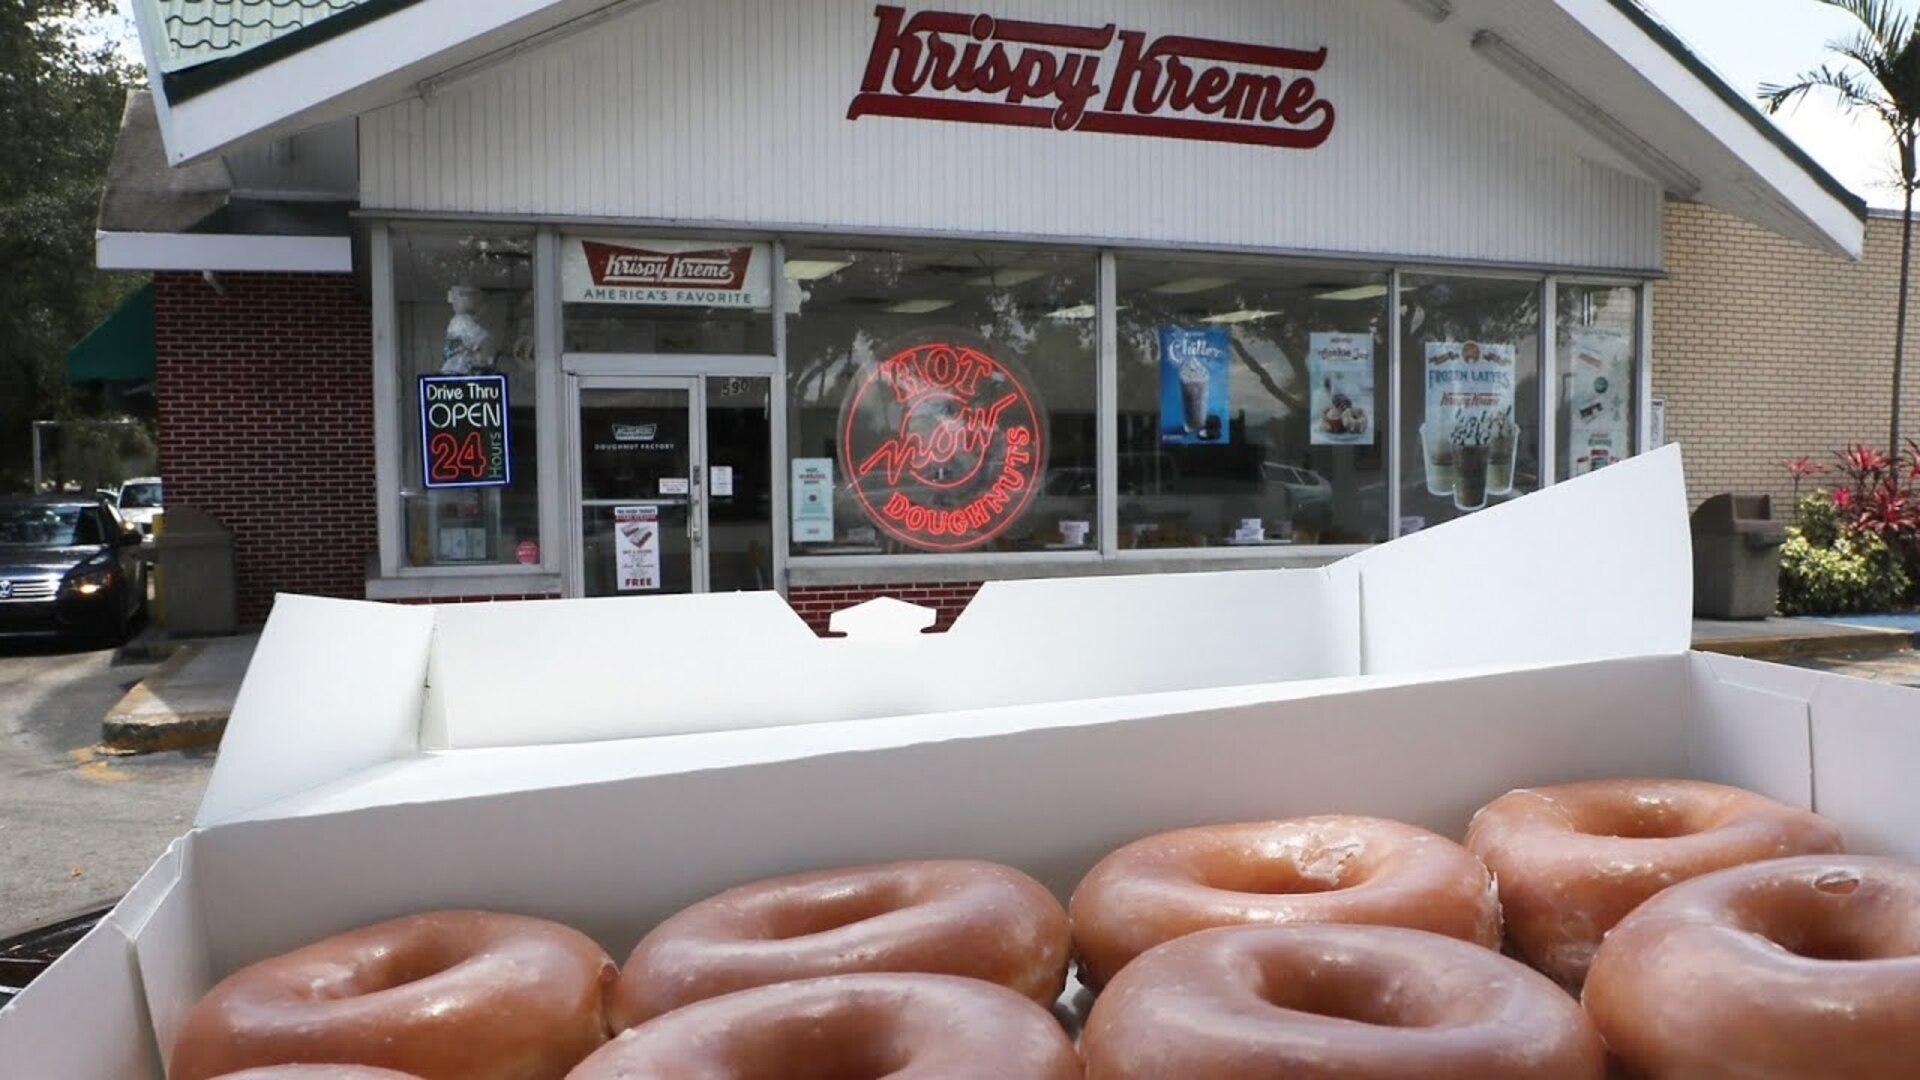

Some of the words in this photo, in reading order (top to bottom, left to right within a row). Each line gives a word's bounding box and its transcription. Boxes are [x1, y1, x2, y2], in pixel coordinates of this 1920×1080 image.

[850, 5, 1114, 131] Krispy
[1103, 30, 1335, 147] Kreme
[604, 254, 669, 282] Krispy
[669, 257, 734, 284] Kreme
[584, 289, 668, 301] AMERICA'S
[676, 291, 752, 303] FAVORITE
[722, 379, 751, 396] 590
[881, 346, 993, 403] HOT
[1429, 370, 1468, 389] FROZEN
[1471, 370, 1511, 389] LATTES
[427, 383, 464, 400] Drive
[467, 382, 499, 399] Thru
[428, 402, 501, 428] OPEN
[860, 392, 1018, 485] now
[431, 431, 487, 480] 24
[489, 432, 503, 479] Hours
[883, 425, 1031, 535] DOUGHNUTS
[625, 578, 653, 587] FREE
